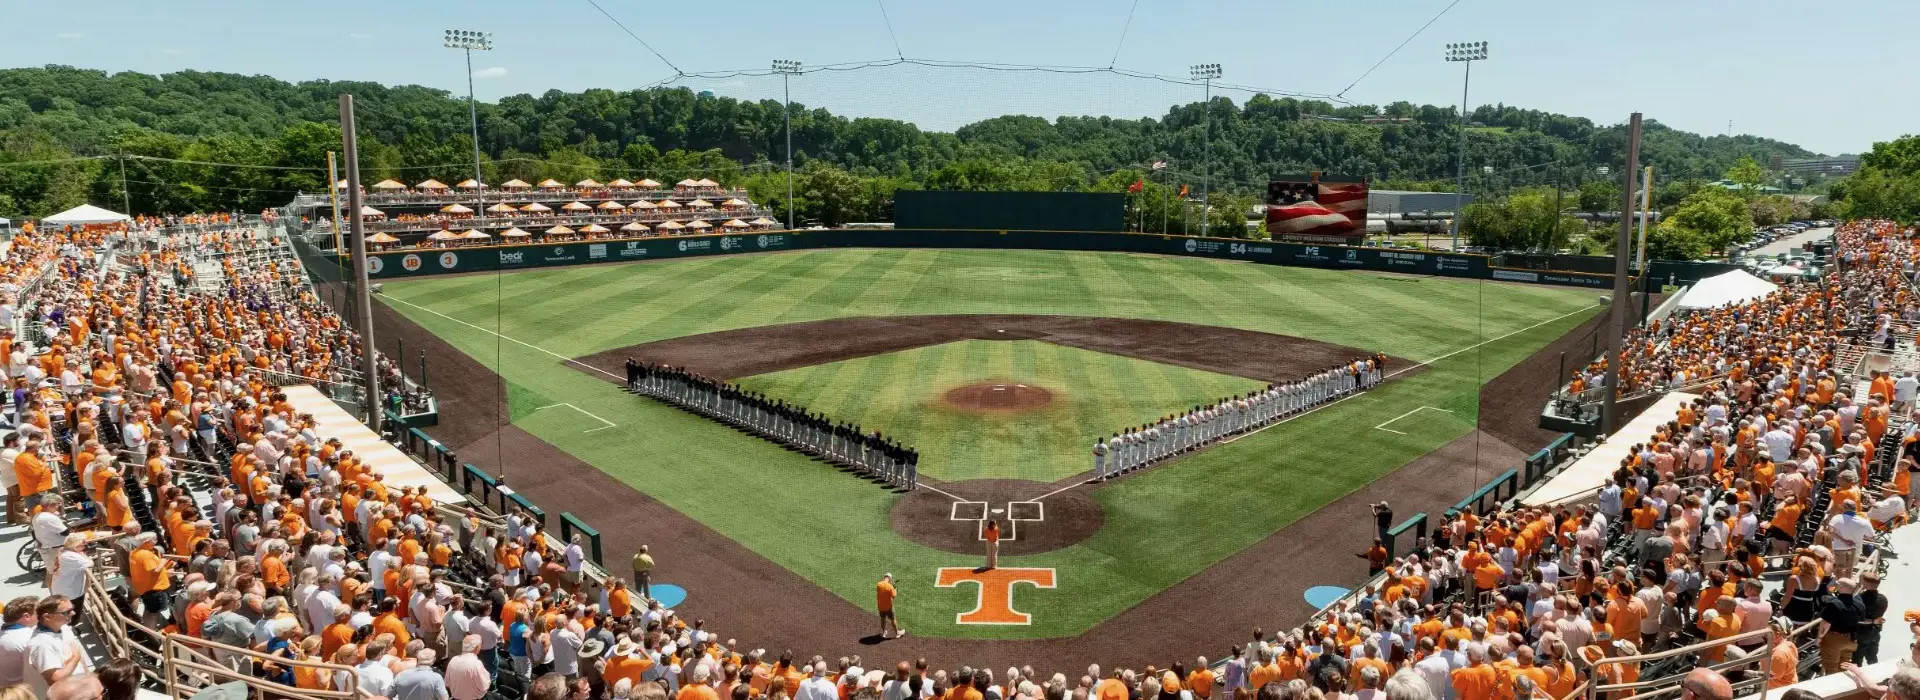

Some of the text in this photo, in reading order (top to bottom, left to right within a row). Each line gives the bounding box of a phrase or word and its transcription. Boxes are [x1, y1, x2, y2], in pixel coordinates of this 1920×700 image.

[679, 240, 687, 251] 6
[1230, 243, 1245, 254] 54
[370, 260, 377, 269] 1
[445, 256, 452, 265] 3
[934, 567, 1057, 625] T
